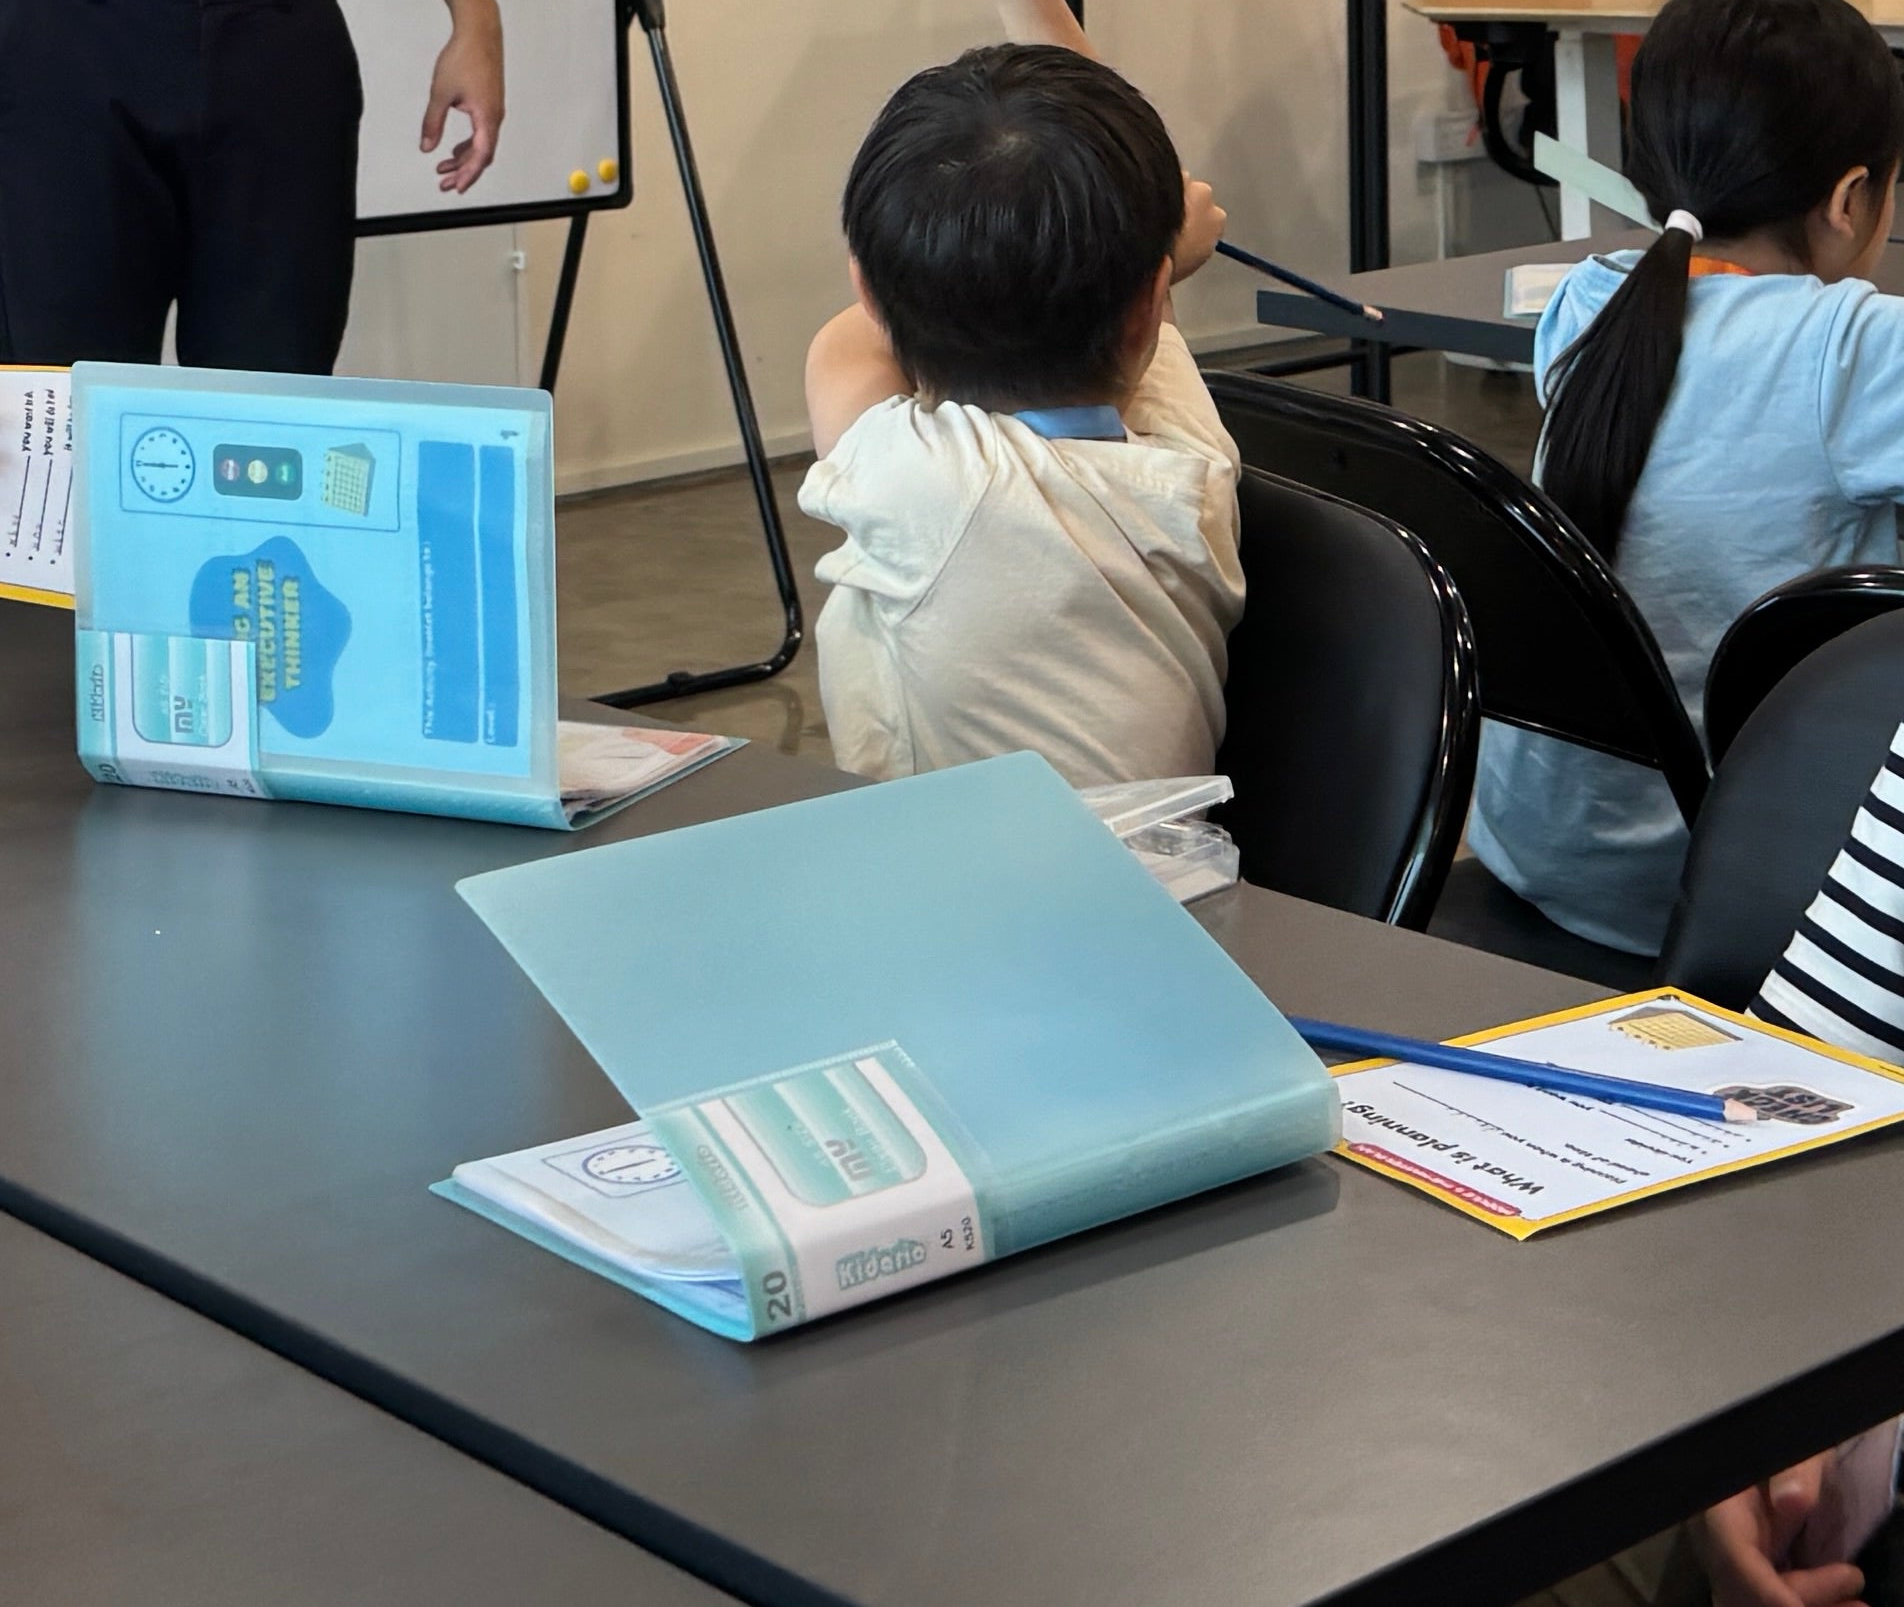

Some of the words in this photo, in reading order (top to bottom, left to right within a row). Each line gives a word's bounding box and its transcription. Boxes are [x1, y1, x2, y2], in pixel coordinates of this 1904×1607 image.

[21, 430, 32, 452] you
[43, 436, 54, 456] you
[232, 567, 251, 610] AN
[255, 559, 277, 703] EXECUTIVE
[282, 575, 301, 691] THINKER
[1450, 1150, 1476, 1164] is
[1473, 1161, 1544, 1195] What
[940, 1228, 953, 1249] A5
[762, 1269, 792, 1322] 20
